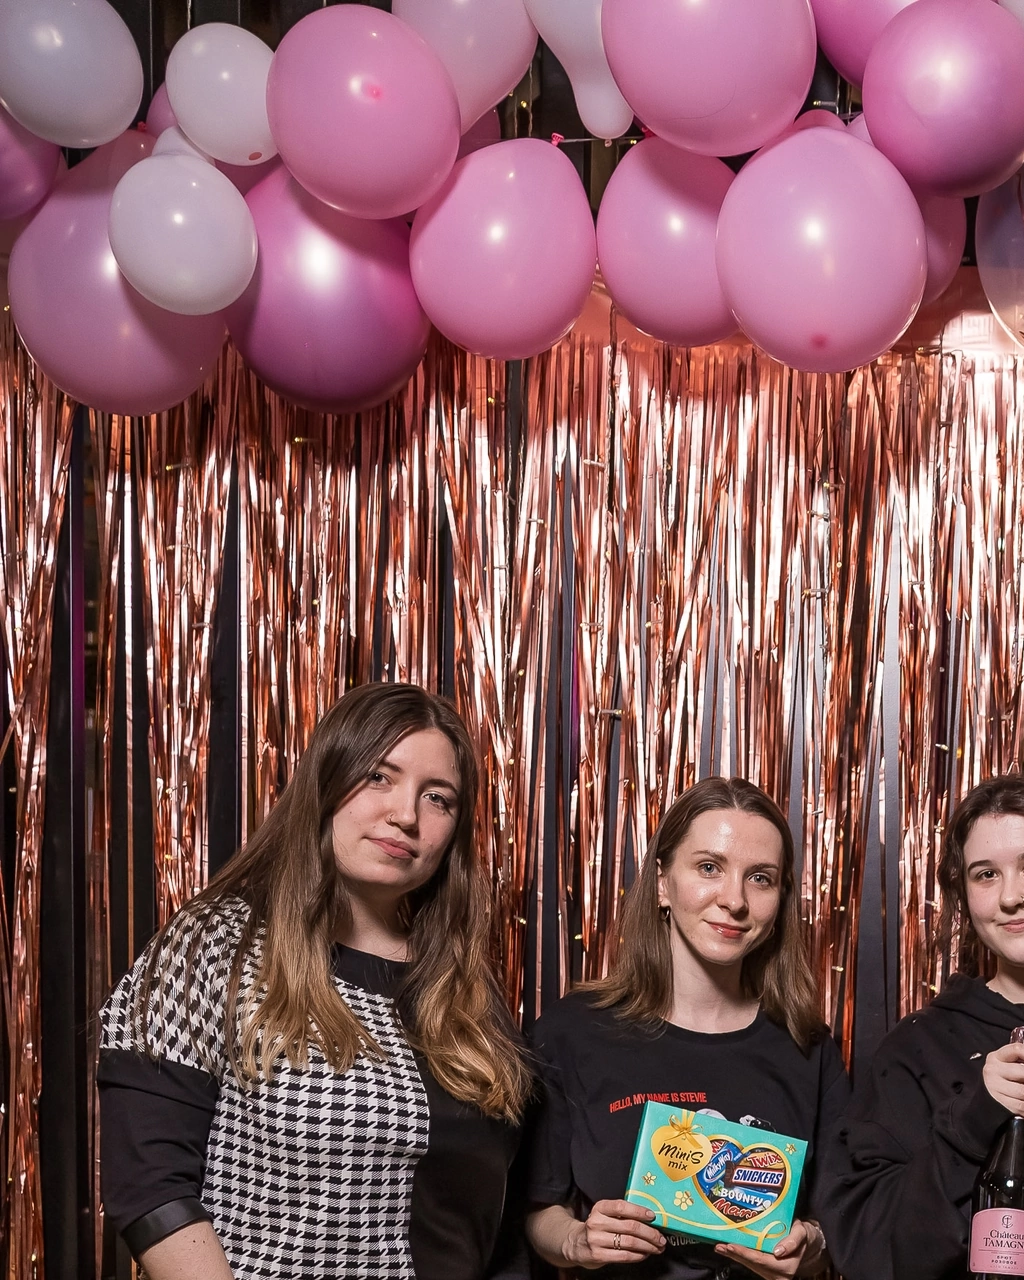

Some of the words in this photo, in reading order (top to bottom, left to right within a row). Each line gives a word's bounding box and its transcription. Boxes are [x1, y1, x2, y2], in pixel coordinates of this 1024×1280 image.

[609, 1097, 633, 1113] HELLO,
[633, 1093, 646, 1105] MY
[647, 1093, 671, 1103] NAME
[671, 1092, 680, 1103] IS
[680, 1092, 707, 1103] STEVIE
[667, 1159, 688, 1171] mix
[733, 1169, 783, 1185] SNICKERS
[720, 1188, 764, 1207] BOUNTY
[989, 1229, 1024, 1241] Château
